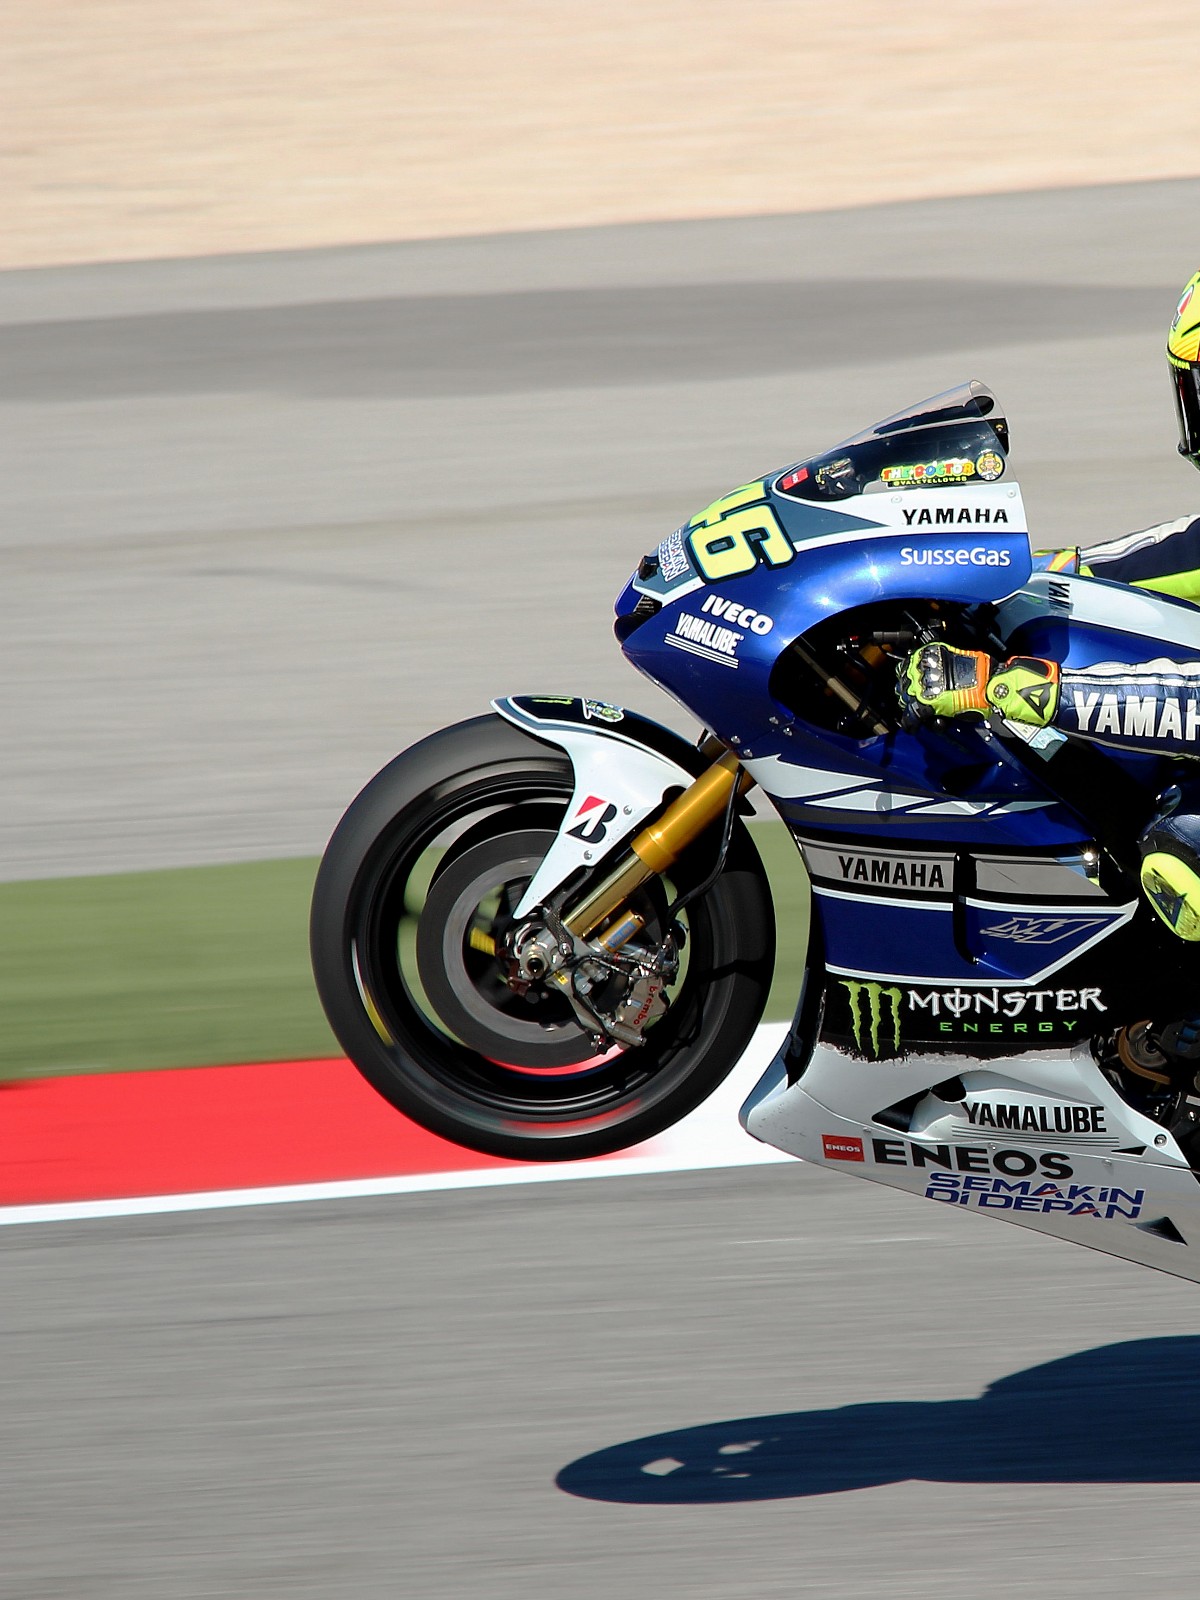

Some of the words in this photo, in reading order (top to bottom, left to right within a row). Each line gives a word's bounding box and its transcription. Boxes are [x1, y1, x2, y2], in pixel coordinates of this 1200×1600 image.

[882, 466, 914, 481] THE
[914, 461, 976, 478] DOCTOR
[902, 508, 1009, 526] YAMAHA
[900, 547, 1011, 567] SuisseGas
[701, 594, 774, 636] IVECO
[675, 612, 740, 656] YAMALUBE
[838, 855, 944, 888] YAMAHA
[633, 985, 659, 1025] brembo
[907, 987, 1108, 1018] MONSTER
[939, 1021, 1078, 1033] ENERGY
[961, 1101, 1107, 1133] YAMALUBE
[825, 1144, 861, 1154] ENEOS
[872, 1138, 1074, 1180] ENEOS
[977, 1196, 1141, 1220] DEPAN
